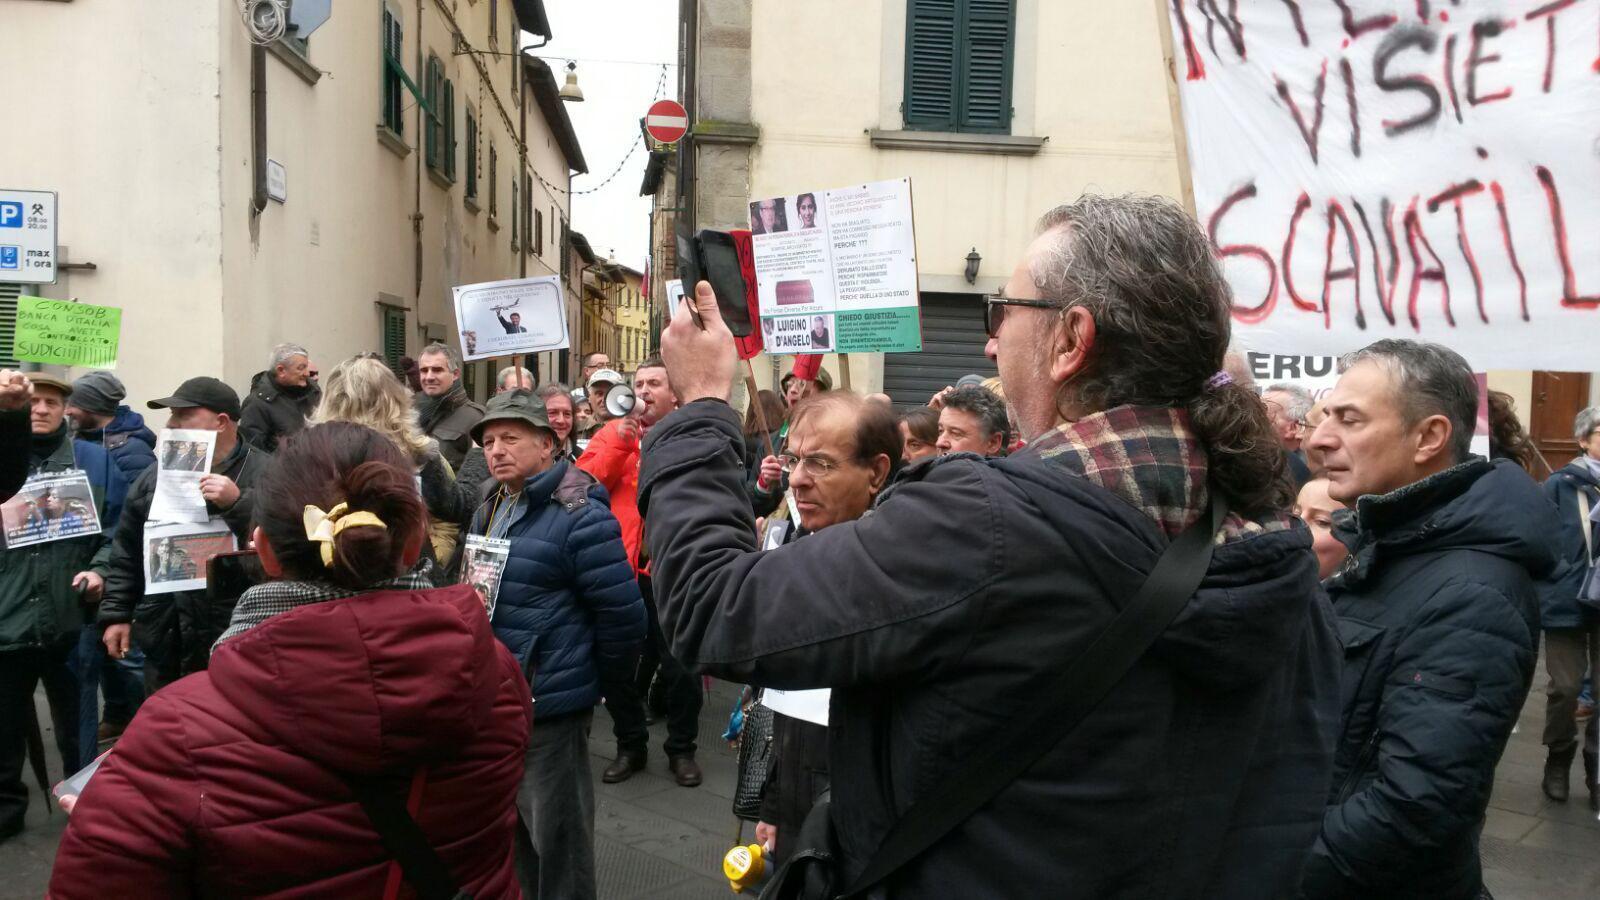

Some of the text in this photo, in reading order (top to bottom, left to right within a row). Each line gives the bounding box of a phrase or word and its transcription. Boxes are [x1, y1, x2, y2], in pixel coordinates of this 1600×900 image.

[1207, 146, 1530, 333] SCAVATI
[26, 258, 30, 267] 1
[34, 260, 52, 268] ora
[18, 310, 57, 322] BANCA
[35, 301, 106, 319] CONSOB
[22, 322, 104, 336] COSA AVETE
[777, 319, 807, 331] LUIGINO
[776, 334, 810, 347] D'ANGELO
[1247, 352, 1344, 380] ERU
